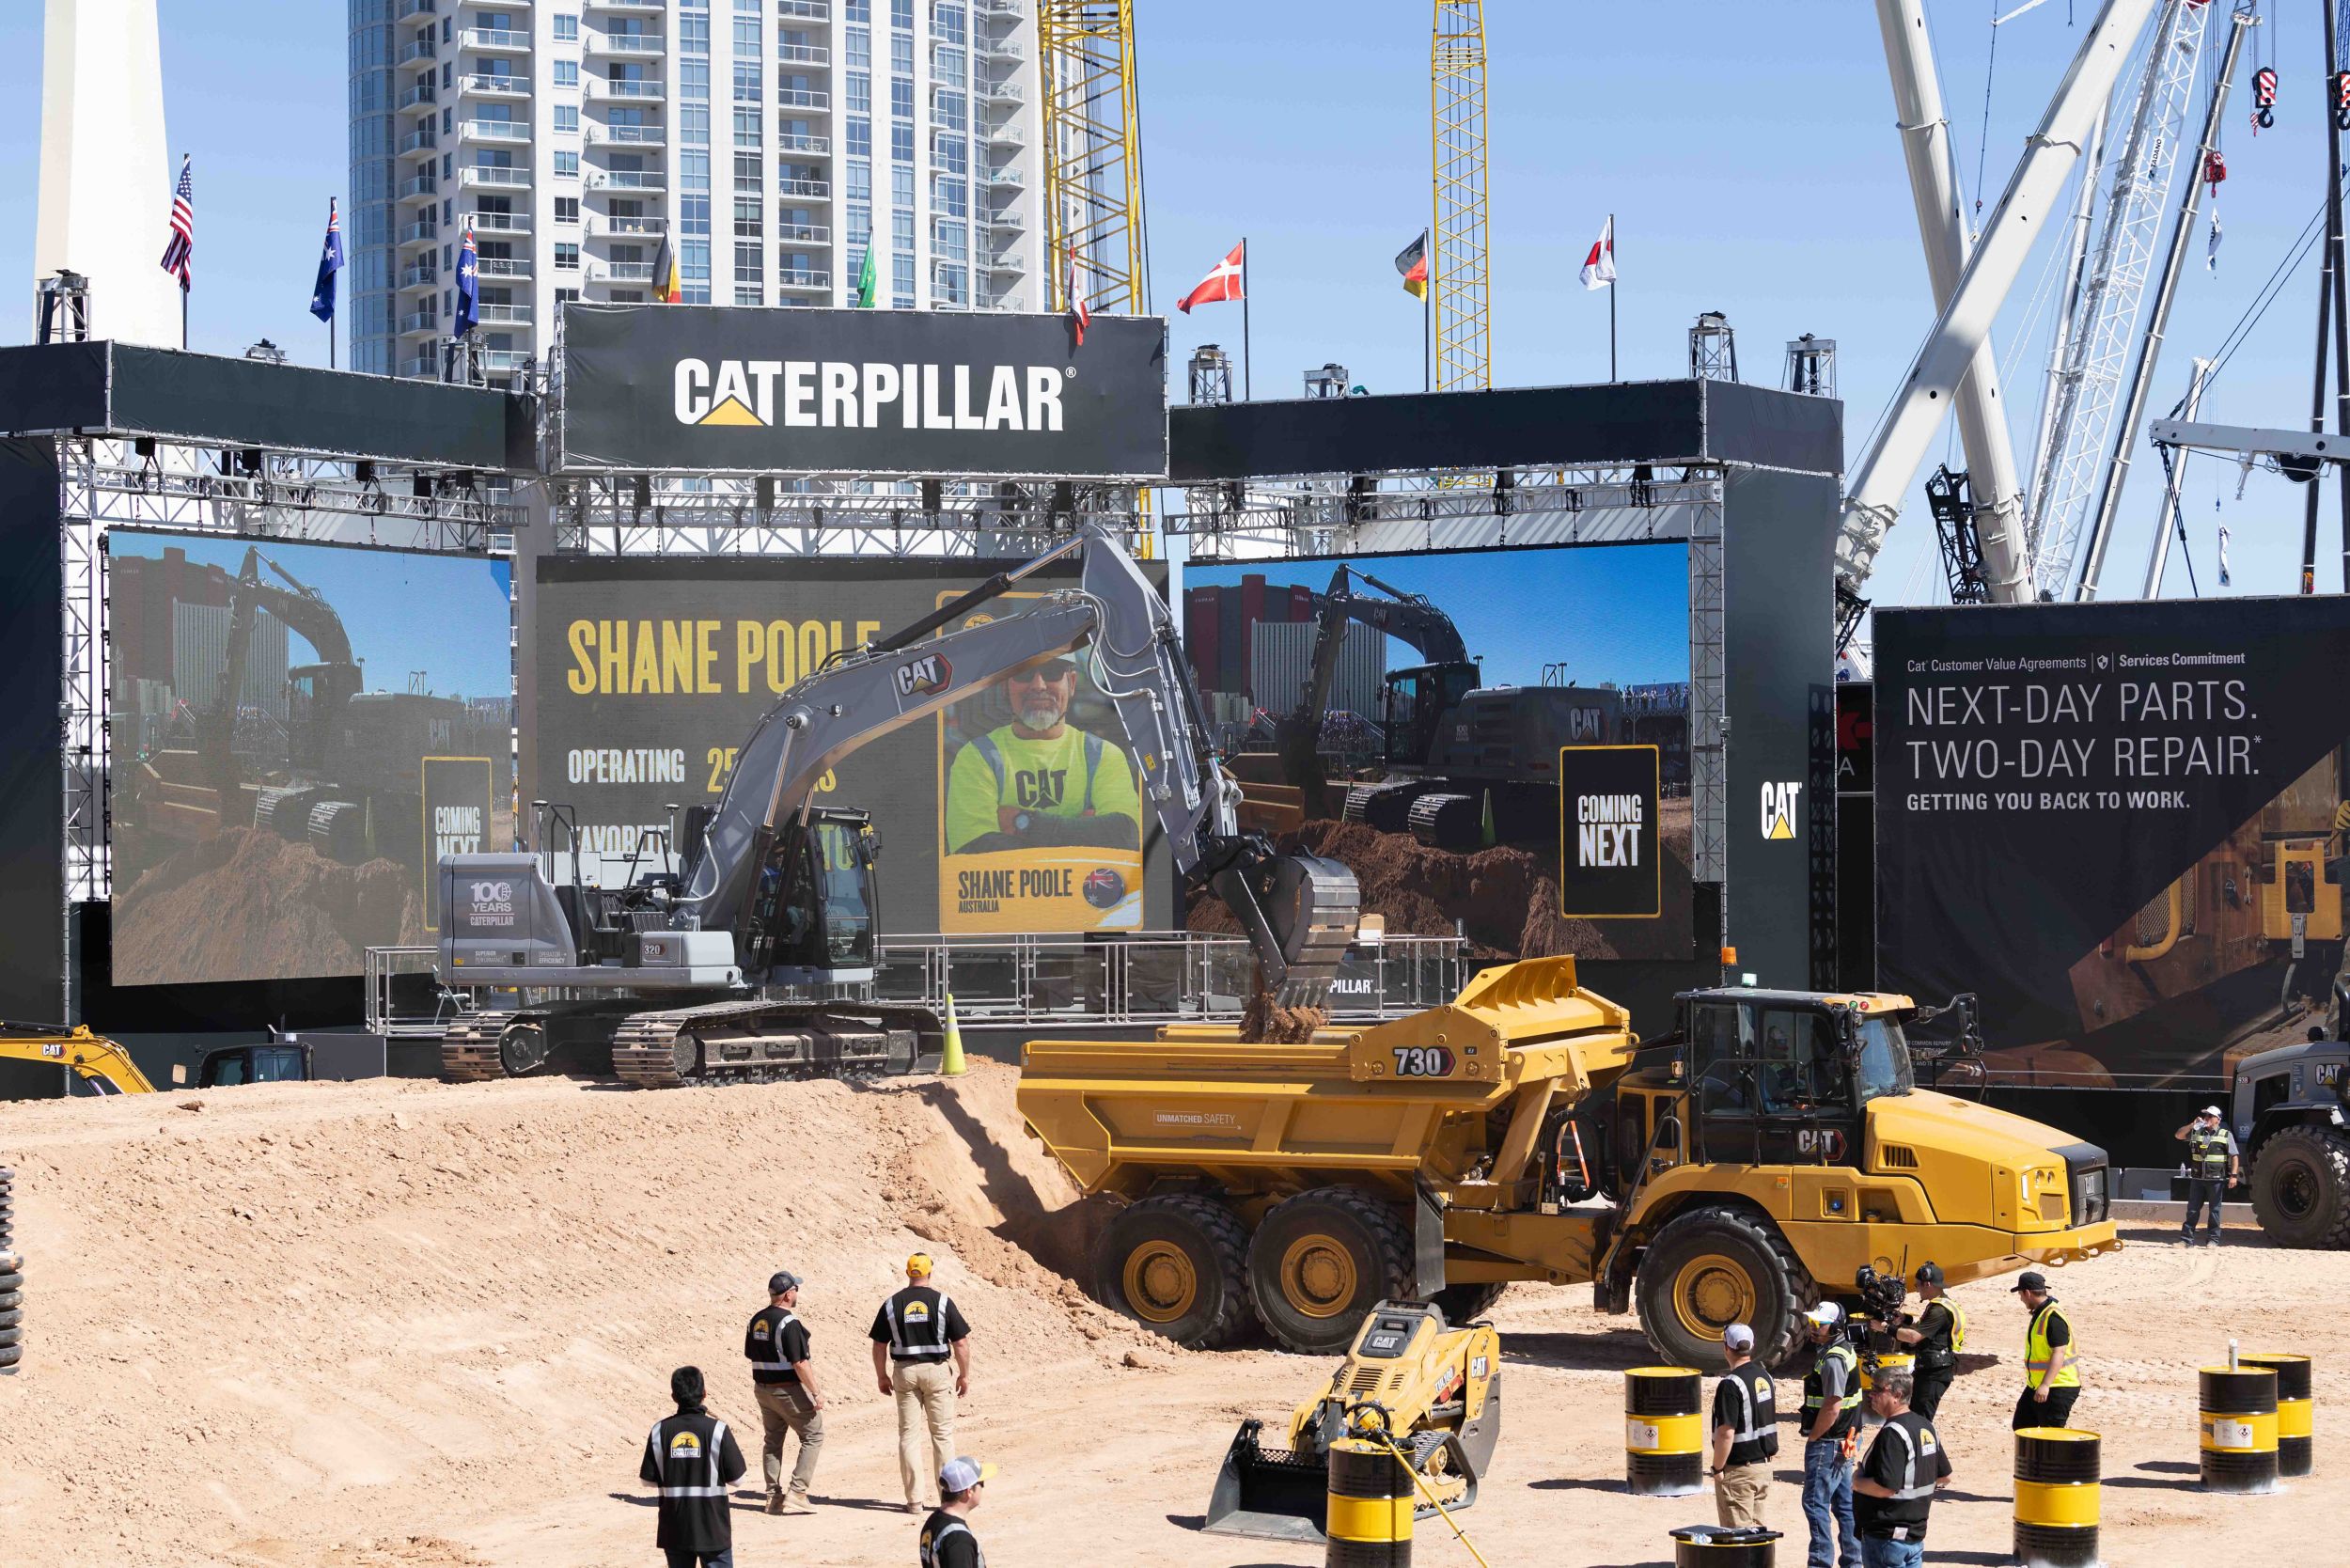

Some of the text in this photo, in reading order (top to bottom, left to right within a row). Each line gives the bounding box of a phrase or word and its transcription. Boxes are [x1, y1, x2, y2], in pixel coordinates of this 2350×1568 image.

[2150, 138, 2162, 168] TADANO
[568, 619, 722, 695] SHANE
[1932, 659, 1982, 671] Customer
[1986, 658, 2016, 670] Value
[2019, 657, 2087, 672] Agreements
[2119, 654, 2170, 668] Services
[2171, 652, 2246, 666] Commitment
[897, 654, 937, 695] CAT
[1907, 681, 2257, 726] NEXT-DAY PARTS.
[1570, 708, 1600, 741] CAT
[568, 748, 685, 784] OPERATING
[1905, 739, 2096, 778] TWO-DAY
[1015, 769, 1067, 808] CAT
[1906, 791, 2190, 811] GETTING YOU BACK TO WORK.
[434, 807, 480, 835] COMING
[1578, 794, 1641, 823] COMING
[1762, 781, 1799, 839] CAT
[1579, 823, 1642, 867] NEXT
[958, 869, 1073, 900] SHANE POOLE
[471, 902, 512, 912] YEARS
[958, 900, 999, 914] AUSTRALIA
[470, 917, 514, 926] CATERPILLAR
[644, 944, 661, 955] 320
[42, 1044, 61, 1056] CAT
[1394, 1048, 1441, 1075] 730
[2315, 1064, 2341, 1085] CAT
[1156, 1113, 1236, 1124] UNMATCHED SAFETY
[1372, 1336, 1398, 1349] CAT
[1471, 1356, 1487, 1378] CAT
